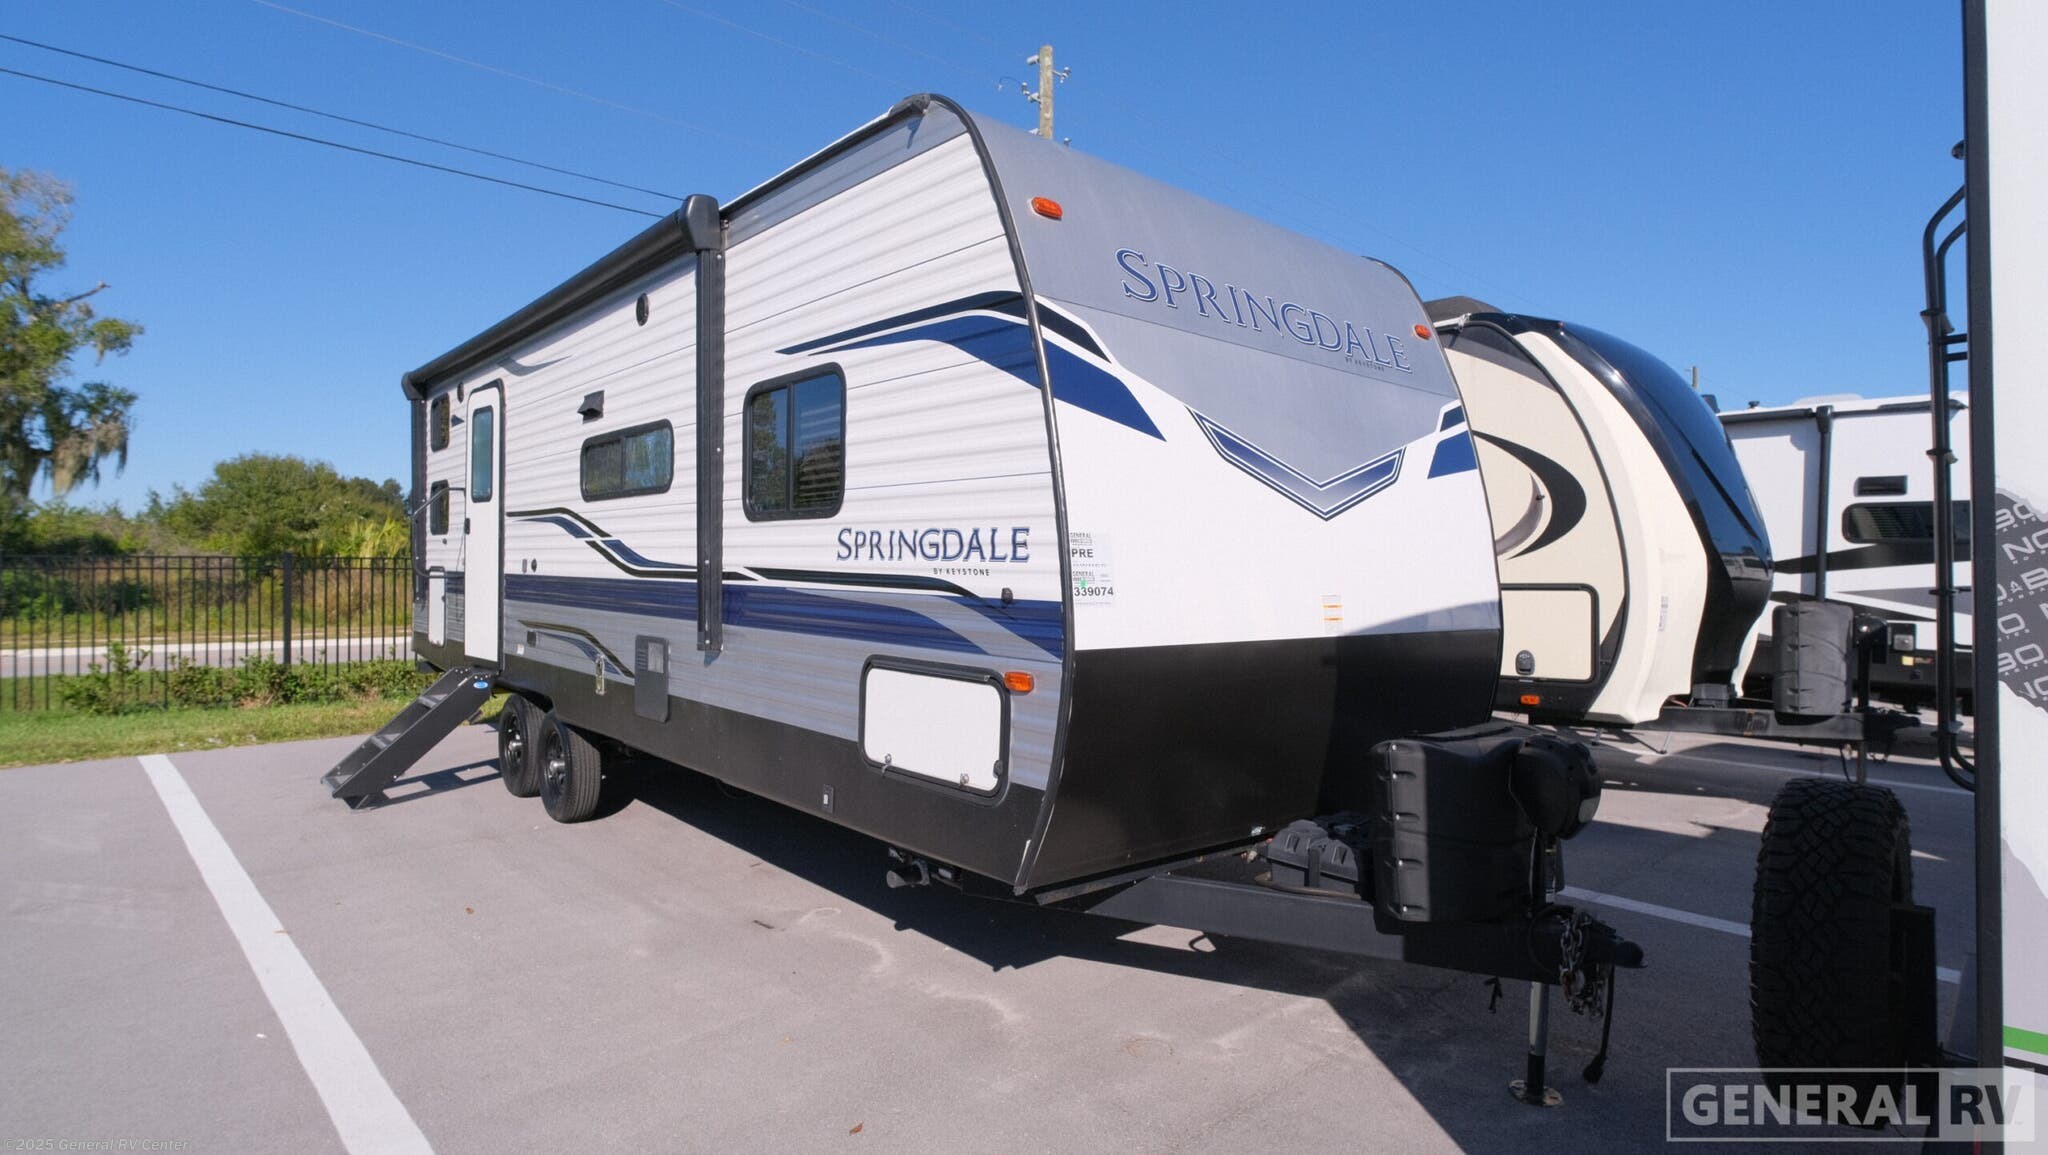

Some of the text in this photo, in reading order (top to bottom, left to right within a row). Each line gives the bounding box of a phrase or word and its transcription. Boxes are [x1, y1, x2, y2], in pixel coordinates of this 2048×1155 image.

[1113, 247, 1413, 373] SPRINGDALE
[836, 527, 1030, 562] SPRINGDALE
[1071, 548, 1094, 558] PRE
[946, 568, 990, 577] KEYSTONE
[1074, 586, 1114, 597] 339074
